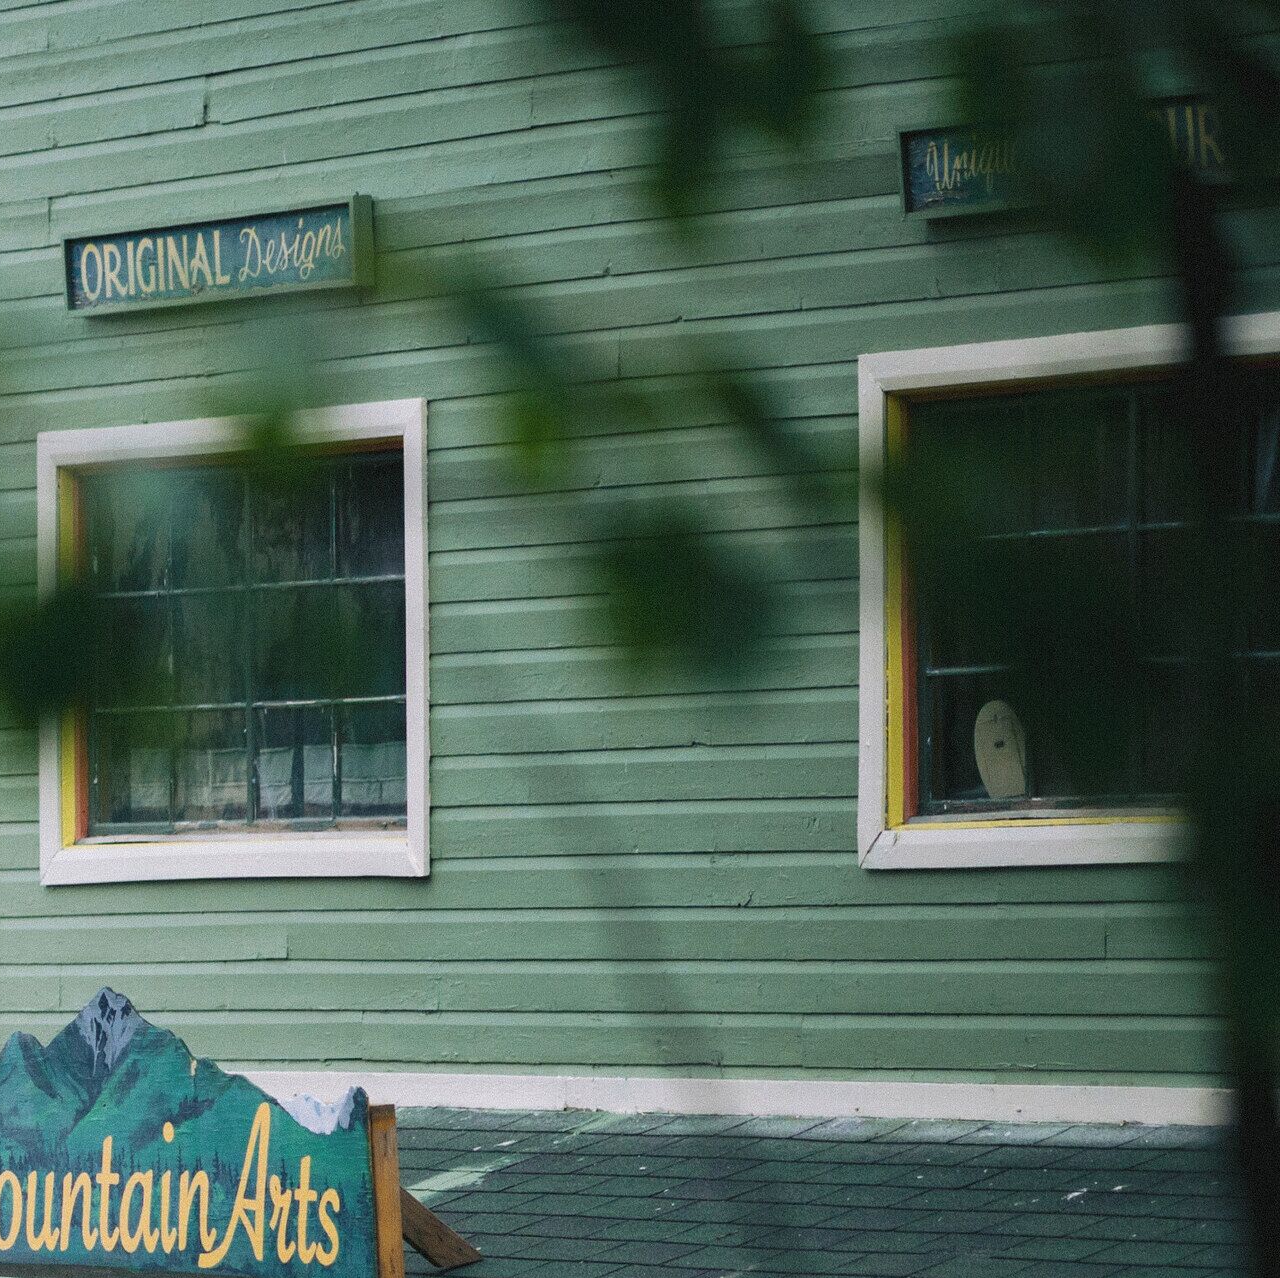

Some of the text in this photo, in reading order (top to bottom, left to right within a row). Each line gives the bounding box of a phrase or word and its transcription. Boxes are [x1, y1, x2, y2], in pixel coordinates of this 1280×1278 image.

[80, 215, 346, 301] ORIGINAL Designs
[197, 1101, 341, 1269] Arts
